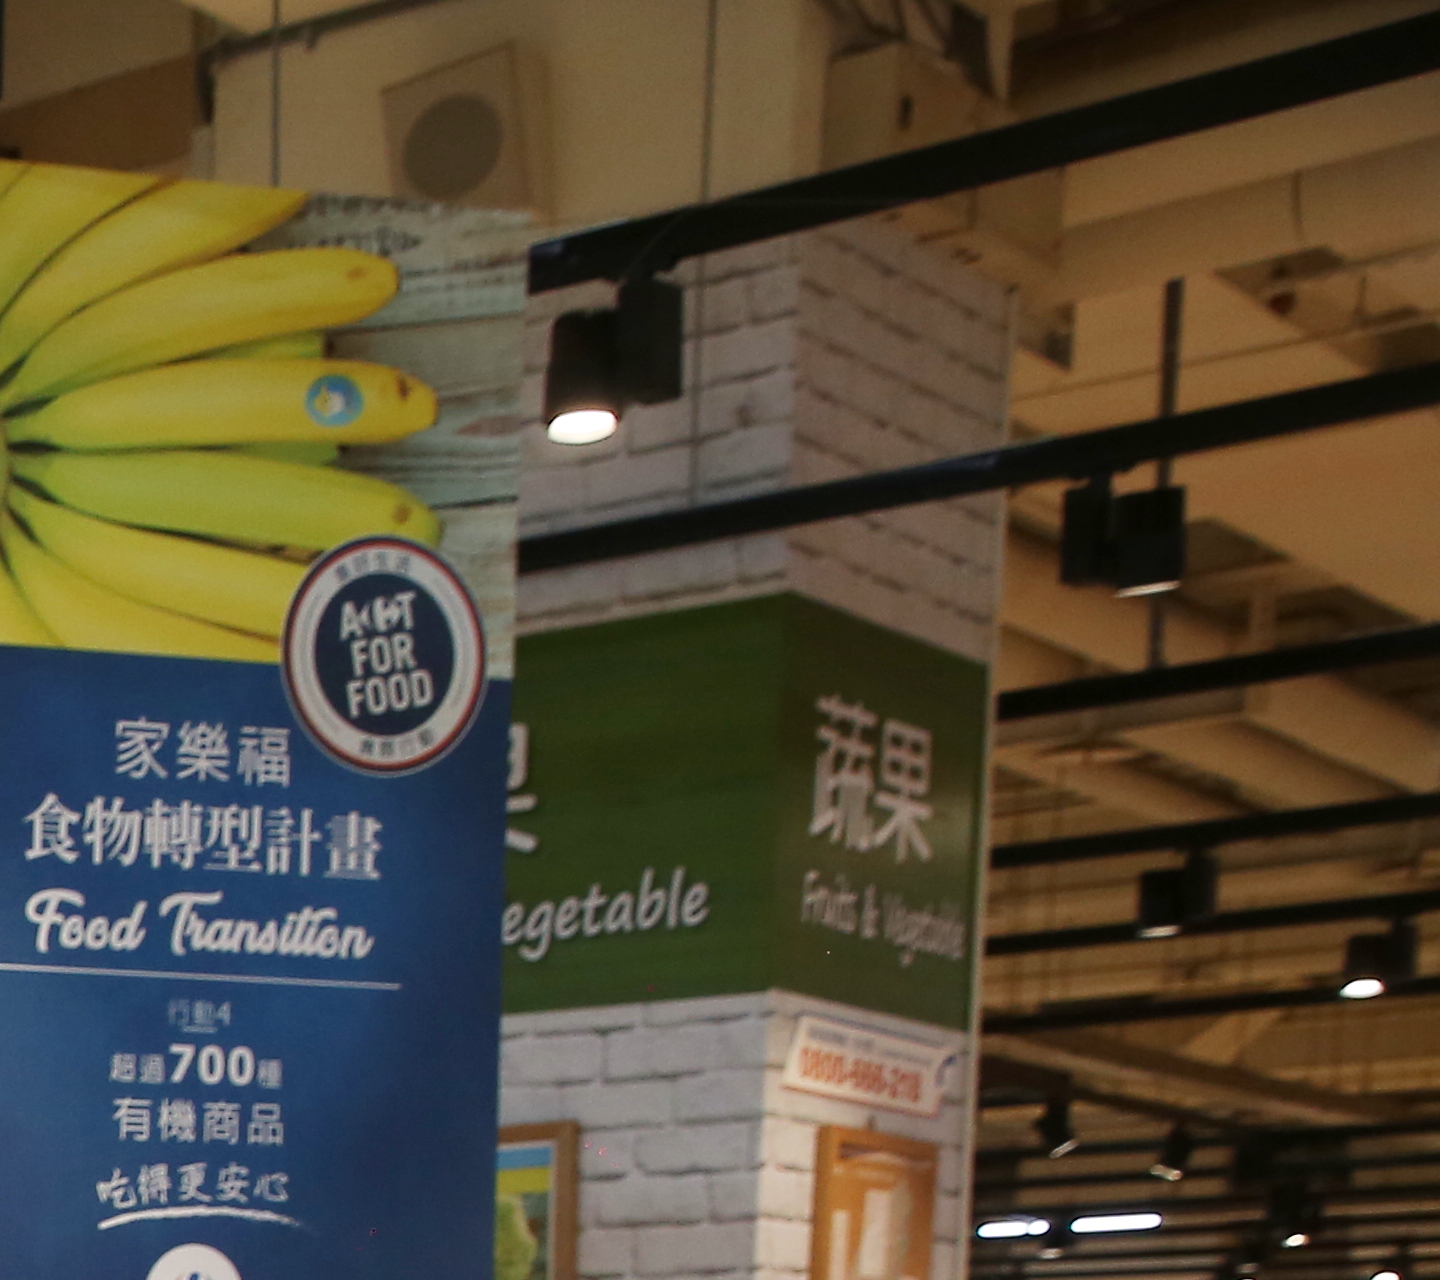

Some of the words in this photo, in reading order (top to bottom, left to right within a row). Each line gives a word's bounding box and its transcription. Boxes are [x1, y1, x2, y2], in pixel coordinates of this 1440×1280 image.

[350, 632, 418, 678] FOR
[346, 669, 434, 719] FOOD
[113, 716, 292, 787] 家樂福
[811, 694, 934, 865] 蔬果
[23, 792, 384, 882] 食物轉型計畫
[23, 887, 147, 956] Food
[159, 889, 376, 961] Transition
[500, 866, 710, 964] egetable
[113, 1097, 284, 1146] 有機商品
[95, 1161, 290, 1209] 吃得更安心
